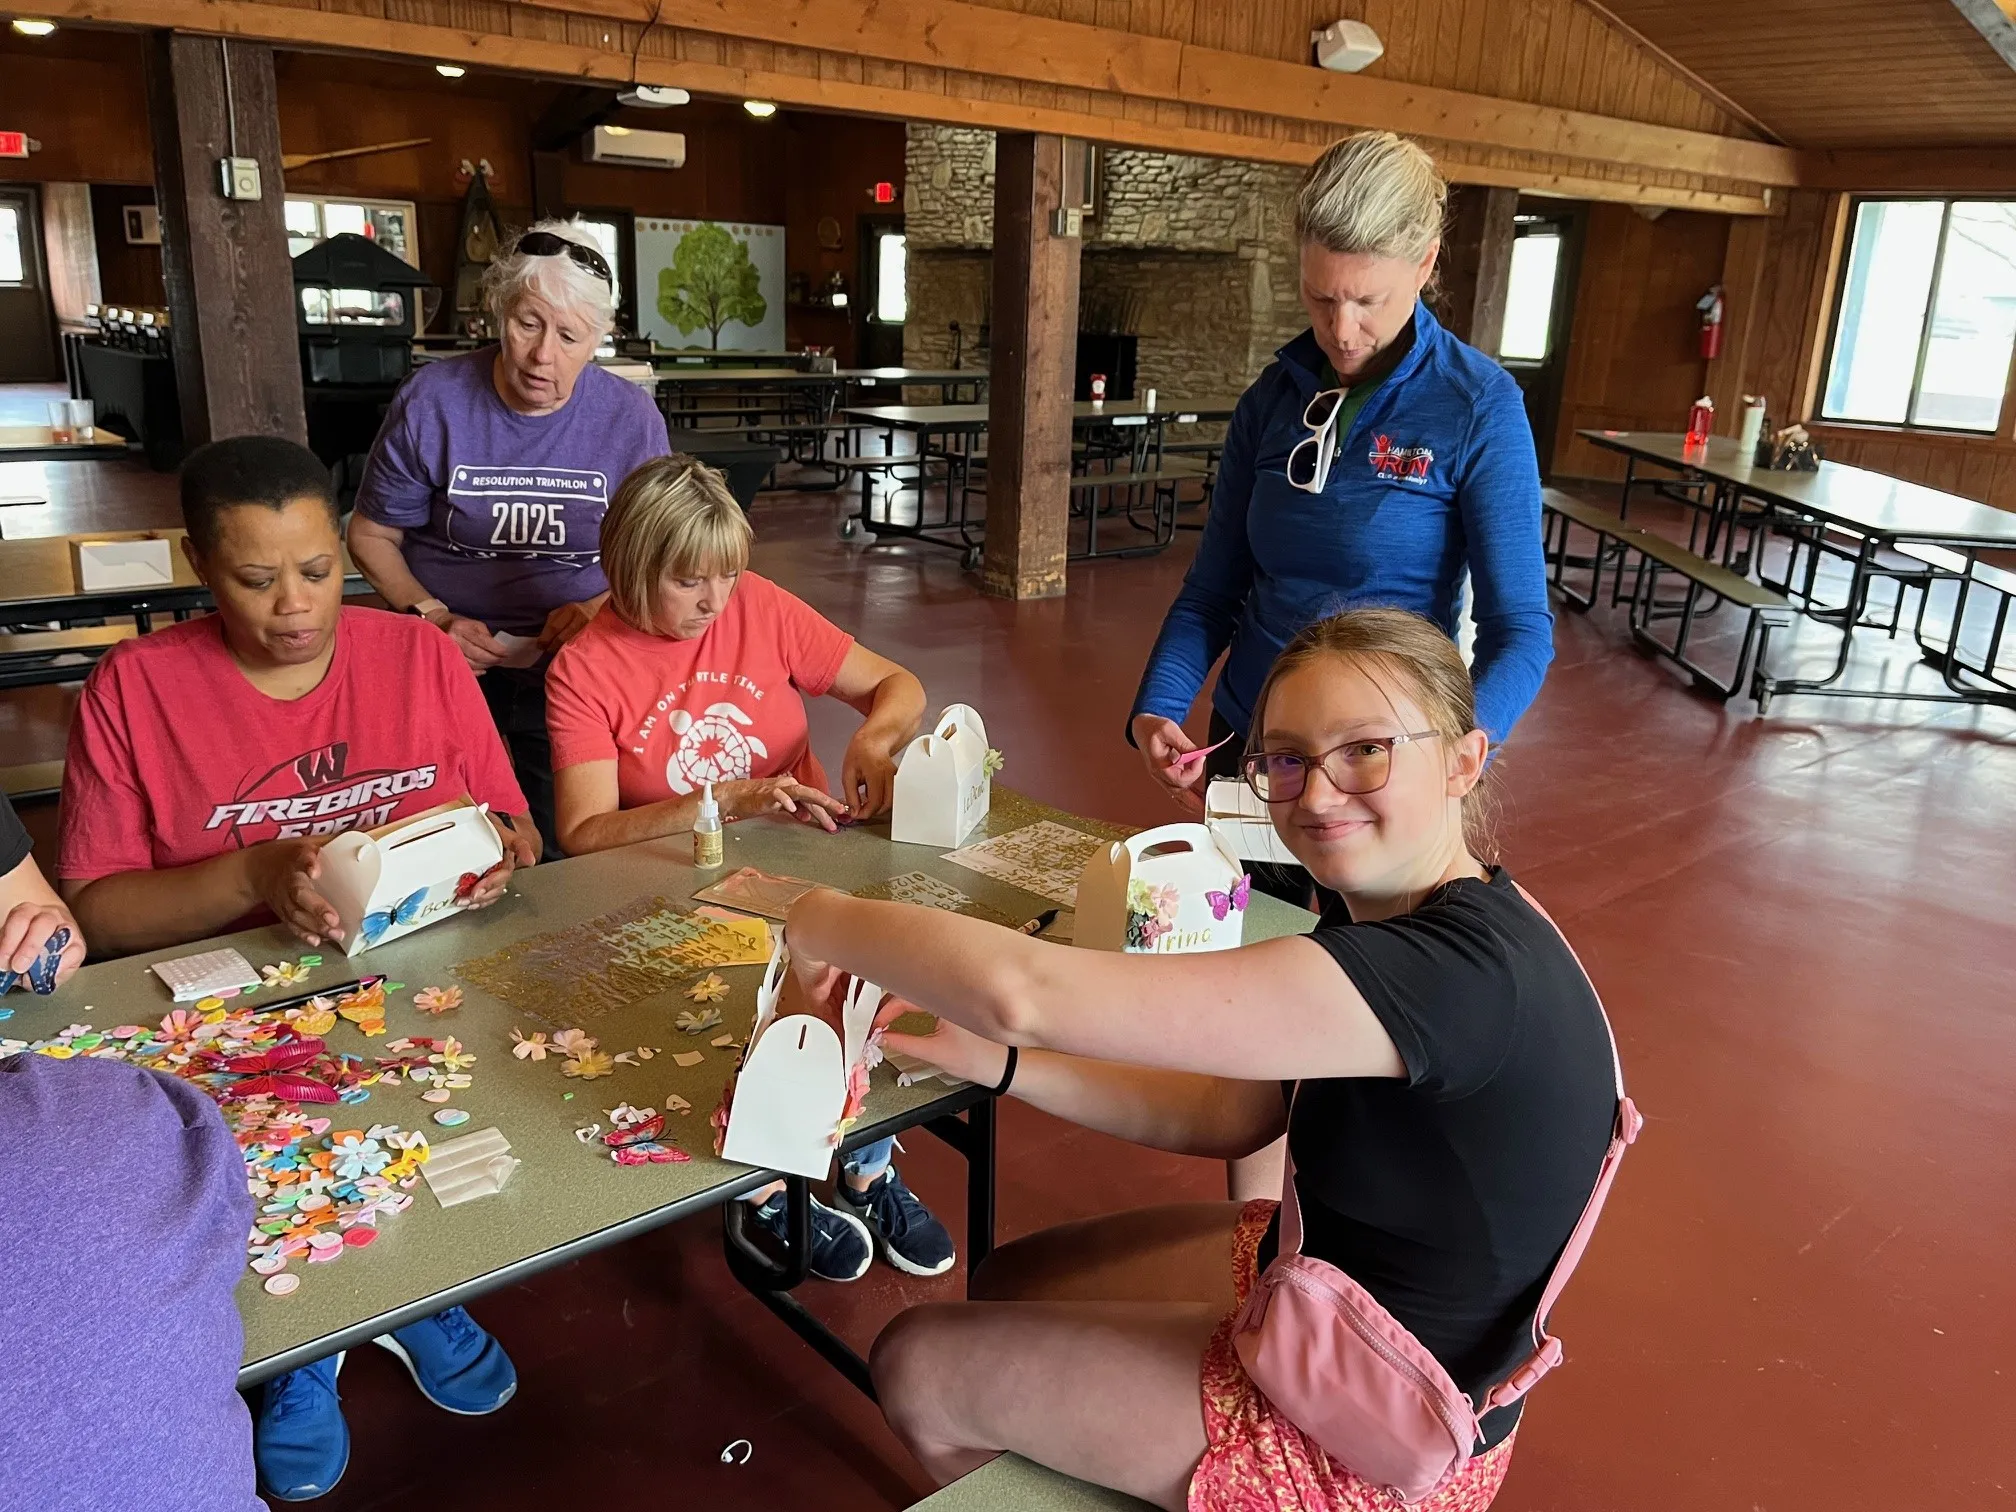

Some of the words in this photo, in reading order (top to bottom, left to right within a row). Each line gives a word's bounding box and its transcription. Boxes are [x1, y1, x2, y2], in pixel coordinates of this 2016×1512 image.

[472, 476, 535, 487] RESOLUTION
[536, 477, 588, 490] TRIATHLON
[1376, 455, 1430, 478] RUN
[490, 502, 566, 546] 2025
[633, 746, 645, 755] I
[639, 715, 657, 740] AM
[656, 691, 676, 712] ON
[678, 671, 729, 693] TURTLE
[732, 674, 765, 701] TIME
[294, 742, 348, 792] W
[203, 764, 438, 830] FIREBIRDS
